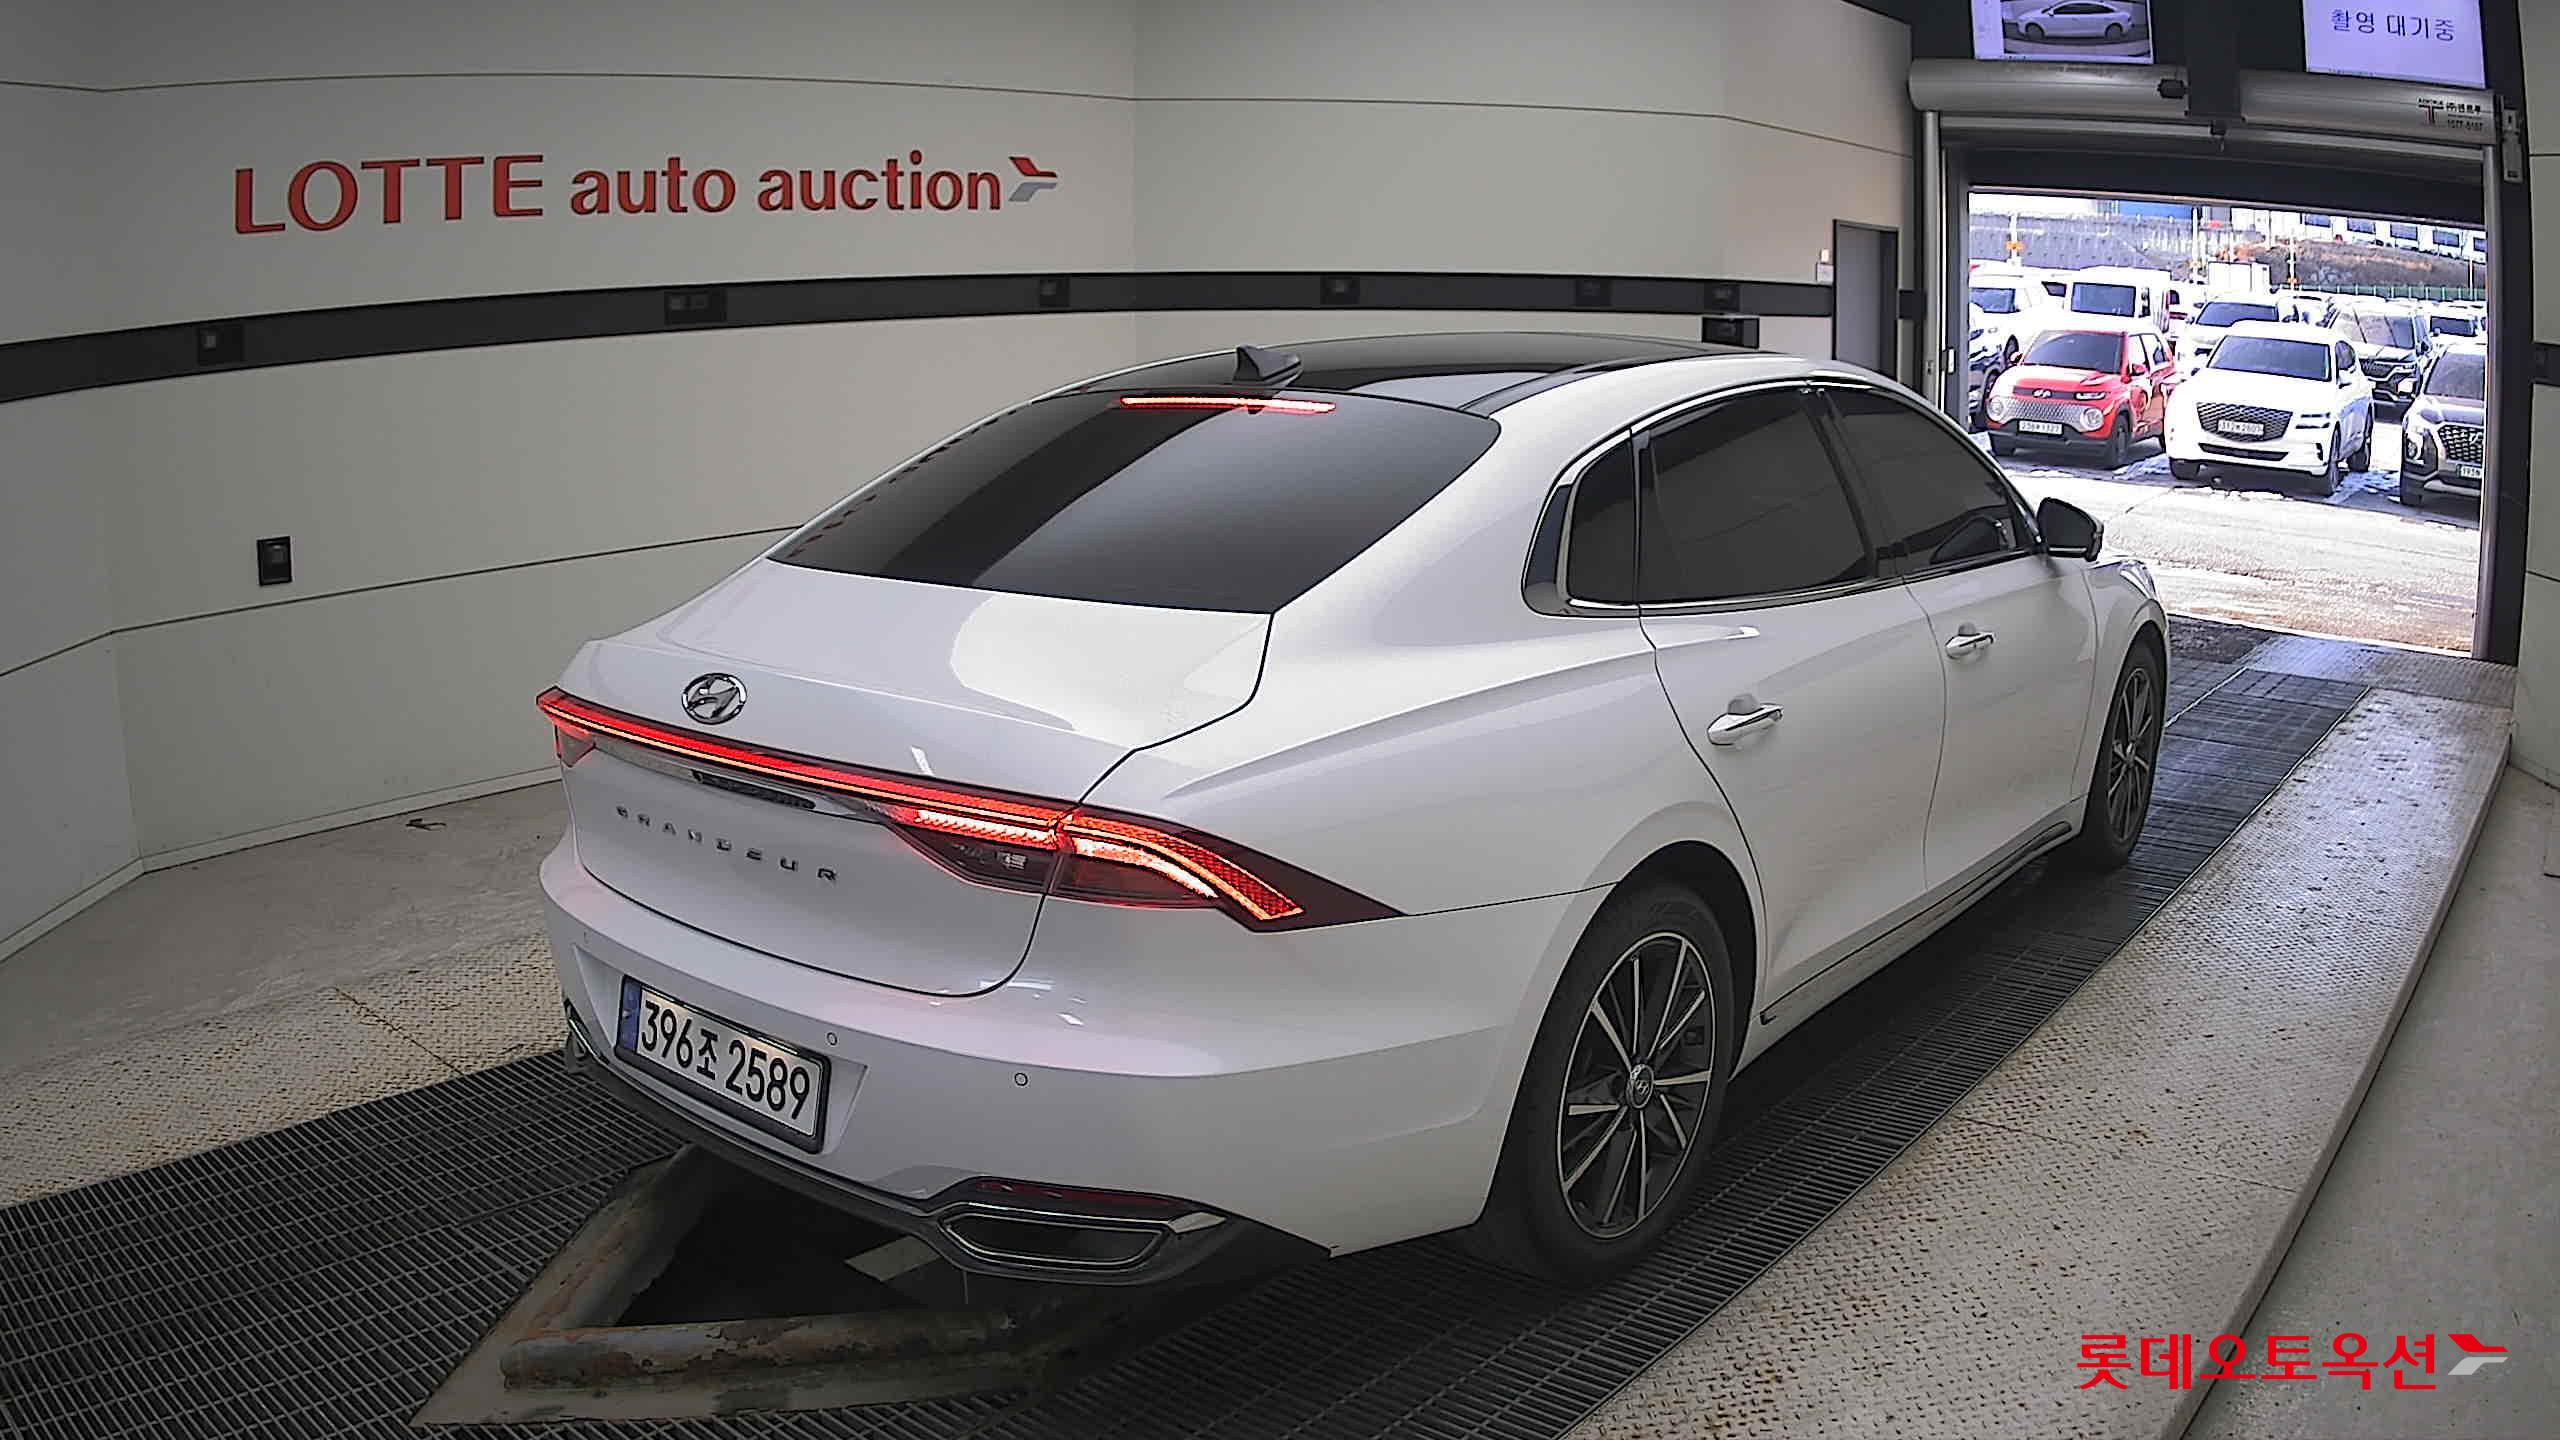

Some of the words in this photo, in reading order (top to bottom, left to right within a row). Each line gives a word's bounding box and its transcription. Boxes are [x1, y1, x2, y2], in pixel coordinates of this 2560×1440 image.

[2331, 9, 2375, 34] 촬영
[2387, 15, 2456, 42] 대기중
[234, 154, 544, 234] LOTTE
[570, 156, 737, 217] auto
[757, 150, 1002, 212] auction
[616, 806, 837, 881] GRANDEUR
[641, 1000, 720, 1080] 396조
[725, 1039, 810, 1119] 2589
